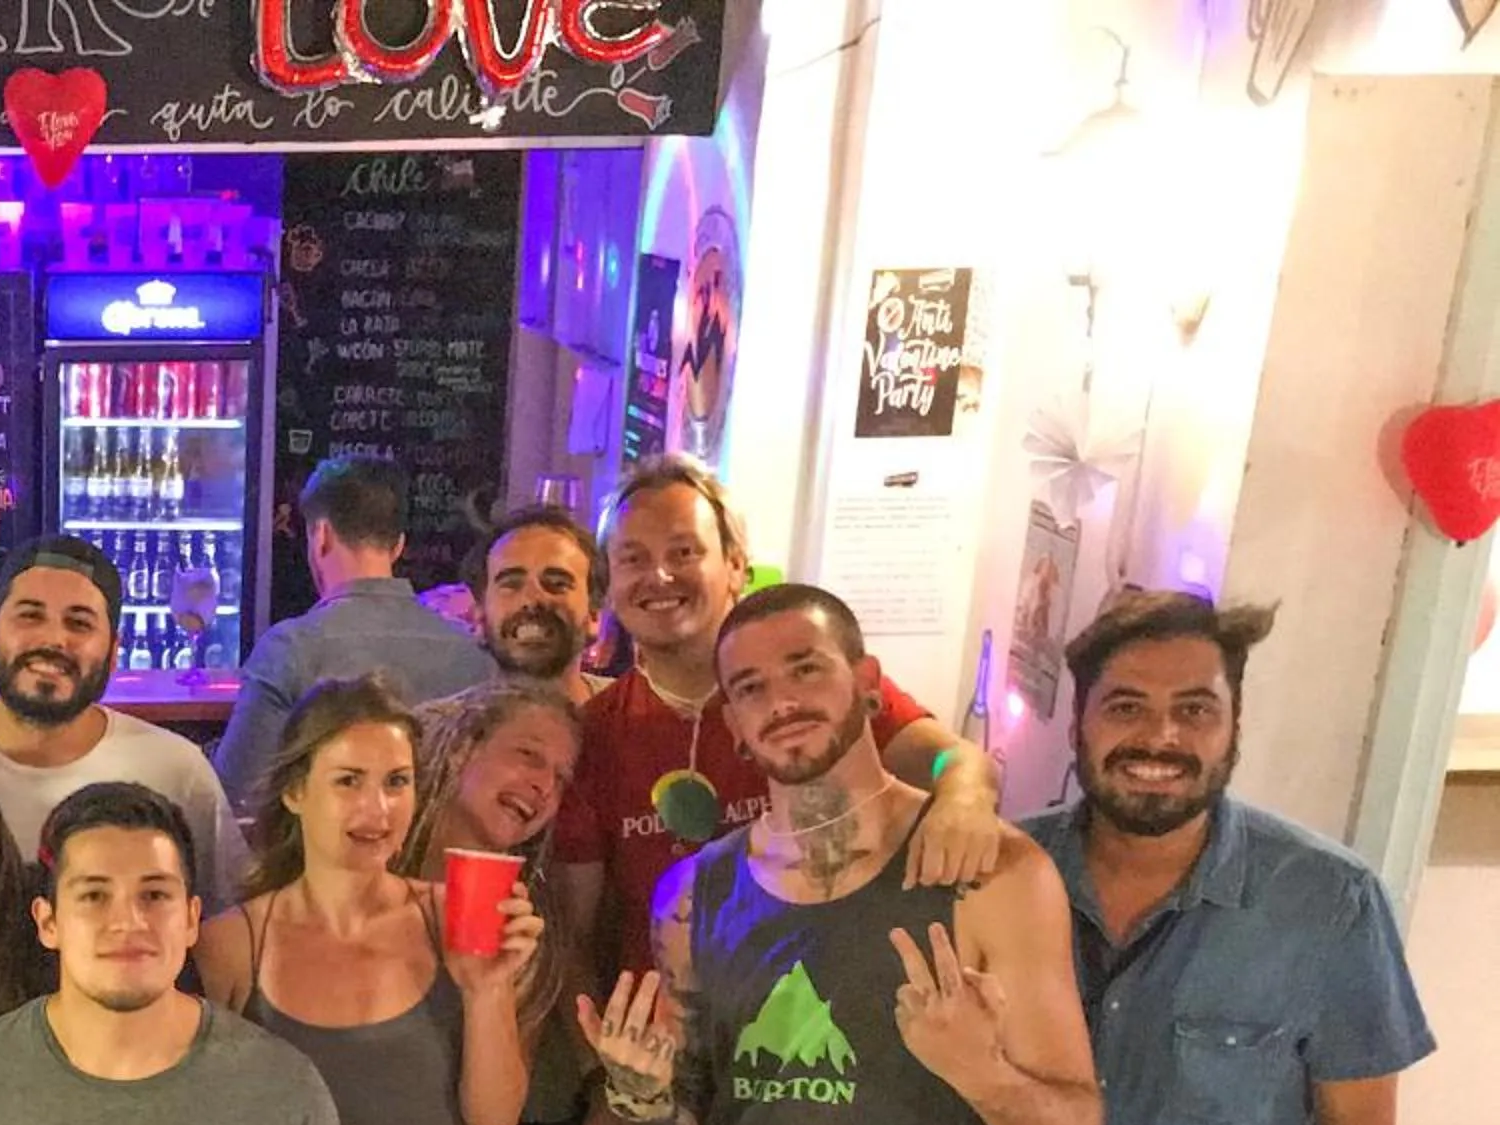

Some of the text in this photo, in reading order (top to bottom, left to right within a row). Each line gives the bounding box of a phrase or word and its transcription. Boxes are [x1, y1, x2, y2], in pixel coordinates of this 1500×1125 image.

[150, 84, 273, 141] quita
[340, 157, 434, 196] Chile
[872, 371, 935, 416] Party
[622, 813, 666, 838] POL
